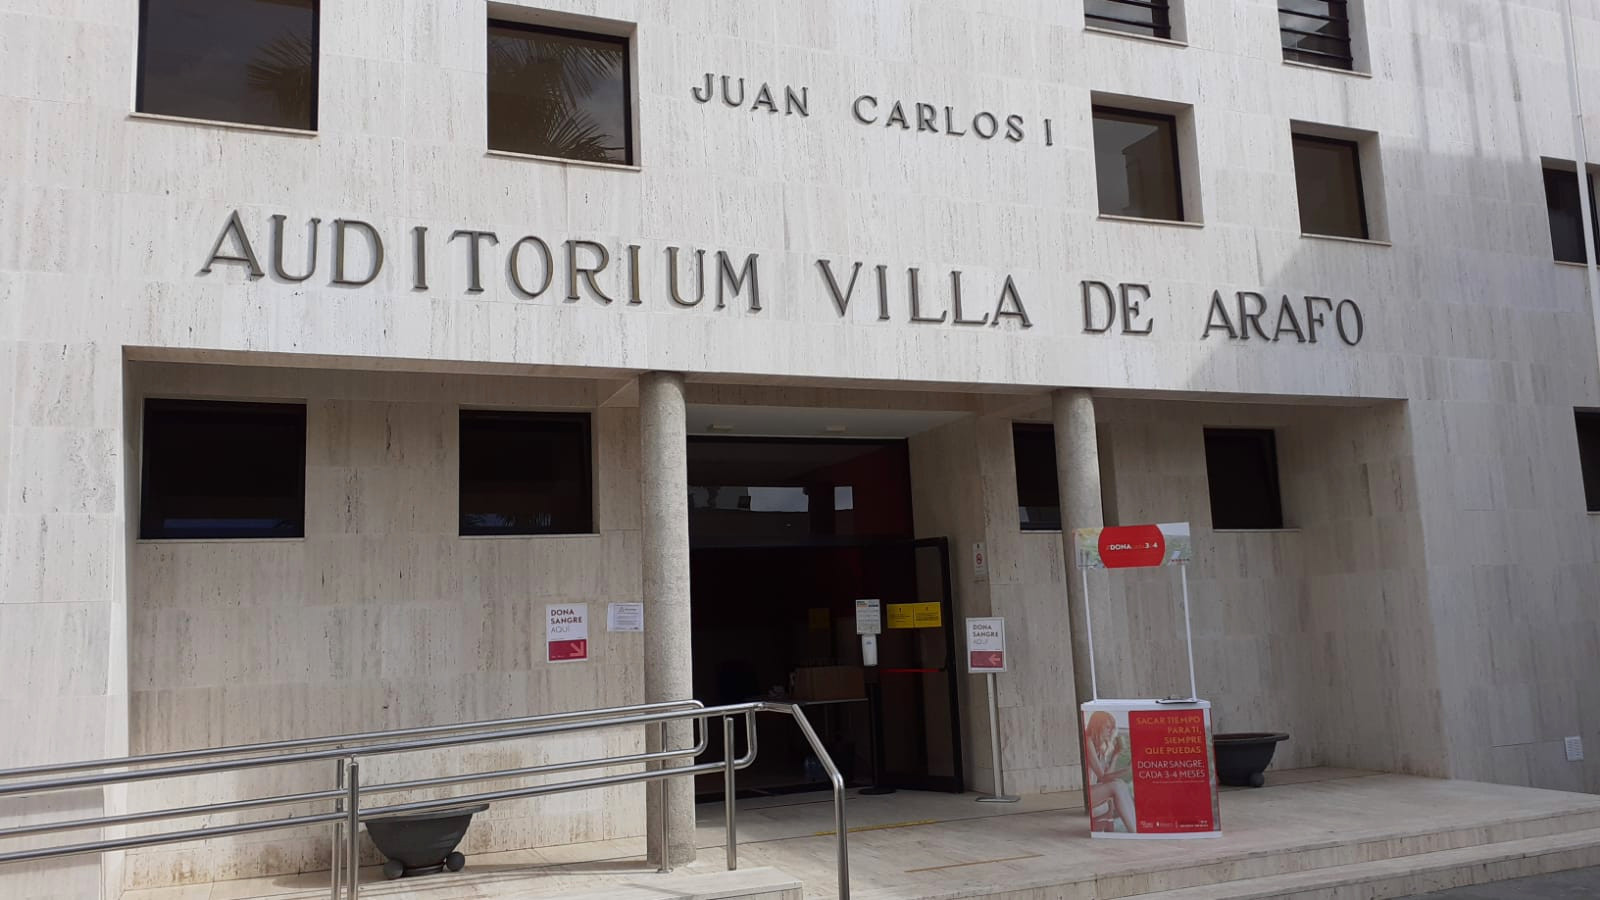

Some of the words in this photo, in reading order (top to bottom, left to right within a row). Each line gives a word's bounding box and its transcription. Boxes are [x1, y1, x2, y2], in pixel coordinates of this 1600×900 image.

[692, 73, 809, 117] JUAN
[851, 95, 1025, 142] CARLOS
[1044, 118, 1054, 146] I
[199, 209, 763, 312] AUDITORIUM
[815, 258, 1033, 328] VILLA
[1081, 280, 1154, 335] DE
[1200, 289, 1364, 346] ARAFO
[550, 608, 575, 616] DONA
[550, 616, 583, 625] SANGRE
[1136, 717, 1166, 725] SACAR
[1167, 716, 1201, 724] TIEMPO
[1164, 736, 1202, 744] SIEMPRE
[1145, 747, 1166, 755] QUE
[1167, 746, 1201, 754] PUEDAS
[1138, 761, 1168, 769] DONAR
[1139, 771, 1163, 779] CADA
[1180, 769, 1205, 778] MESES
